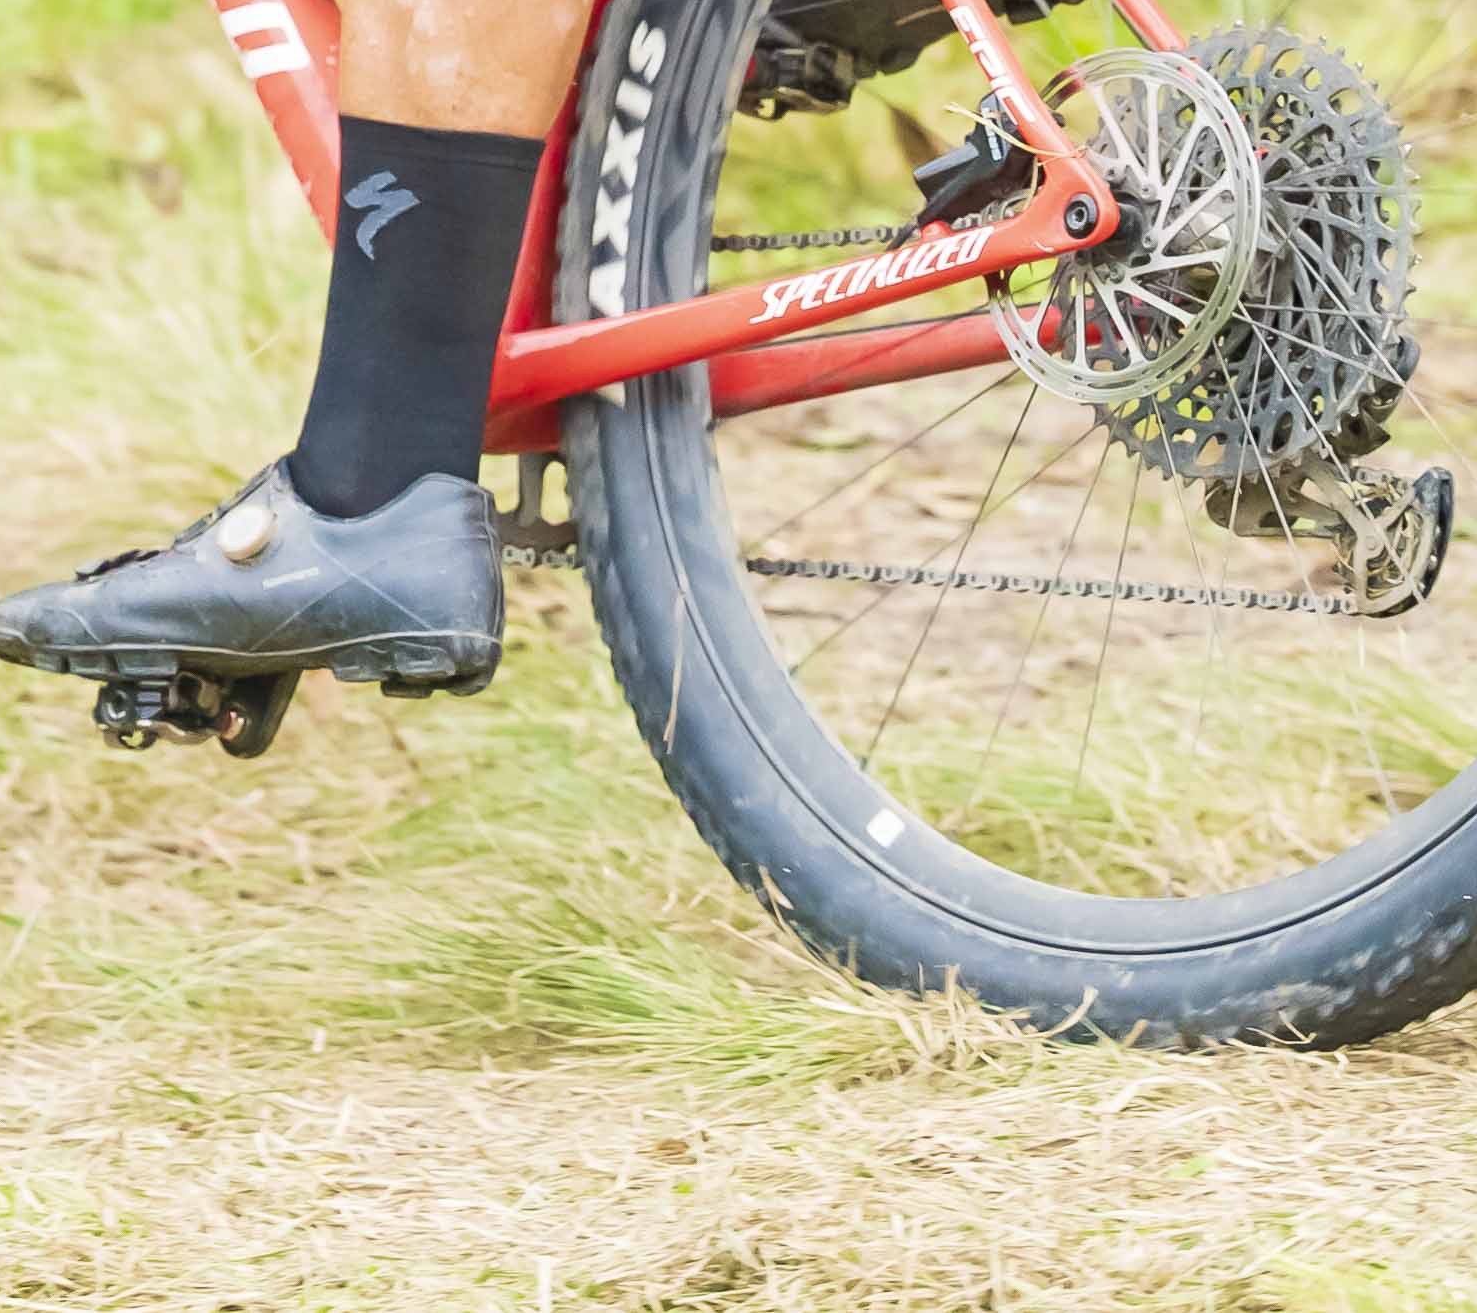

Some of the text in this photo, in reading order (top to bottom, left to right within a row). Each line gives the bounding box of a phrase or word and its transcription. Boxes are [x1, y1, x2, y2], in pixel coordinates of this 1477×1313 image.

[949, 5, 1037, 127] EPIC
[588, 20, 667, 410] AXXIS
[749, 225, 995, 324] SPECIALIZED
